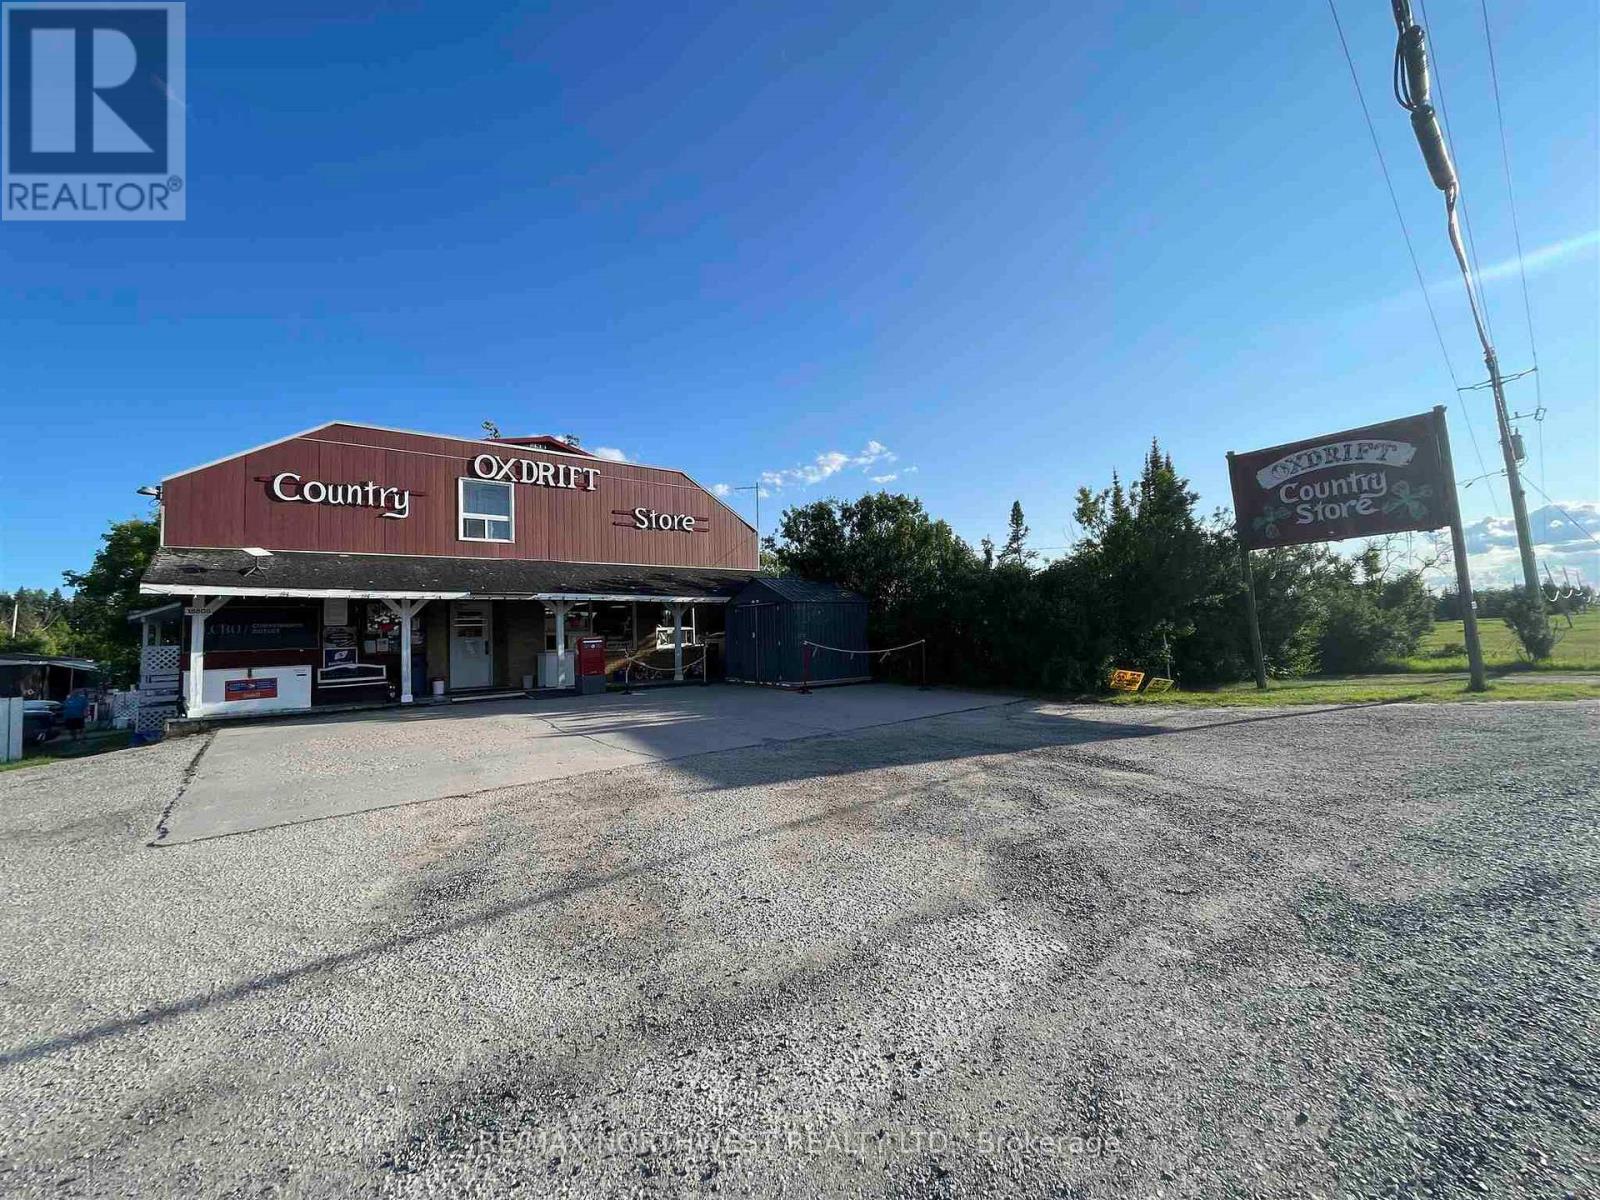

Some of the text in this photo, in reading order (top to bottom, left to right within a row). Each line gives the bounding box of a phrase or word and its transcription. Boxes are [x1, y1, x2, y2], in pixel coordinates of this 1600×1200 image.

[473, 454, 600, 491] OXDRIFT
[1271, 441, 1398, 481] OXDRIFT
[273, 472, 410, 518] Country
[1279, 470, 1388, 504] Country
[634, 507, 696, 532] Store
[1296, 497, 1381, 525] Store
